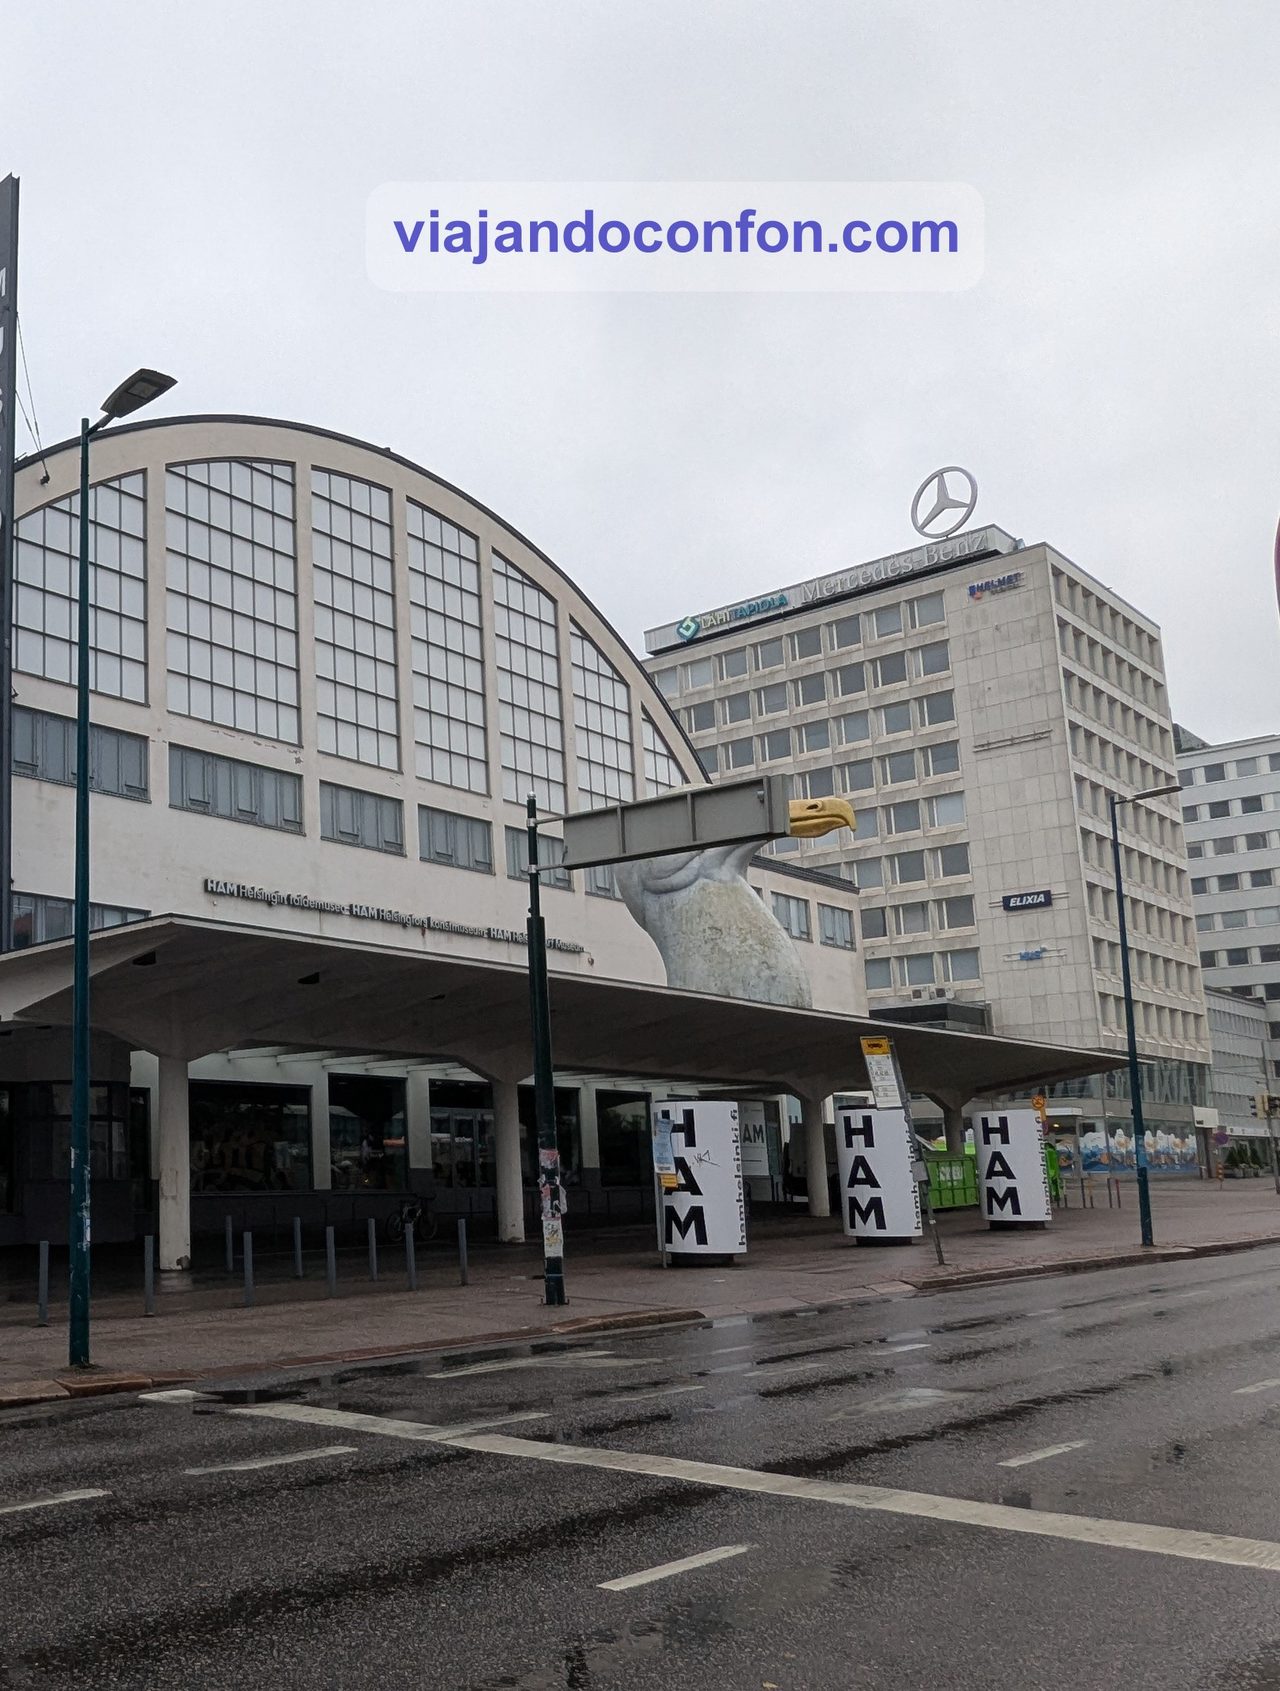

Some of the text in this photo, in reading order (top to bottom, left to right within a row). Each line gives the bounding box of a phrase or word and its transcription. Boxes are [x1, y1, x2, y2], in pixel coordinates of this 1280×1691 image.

[801, 533, 988, 603] Mercedes-Benz
[206, 878, 238, 897] HAM
[239, 884, 288, 905] Helsingin
[351, 903, 378, 920] HAM
[489, 927, 512, 942] HAM
[1009, 894, 1045, 907] ELIXIA
[661, 1109, 708, 1245] HAM
[843, 1115, 887, 1230] HAM
[981, 1116, 1022, 1216] HAM
